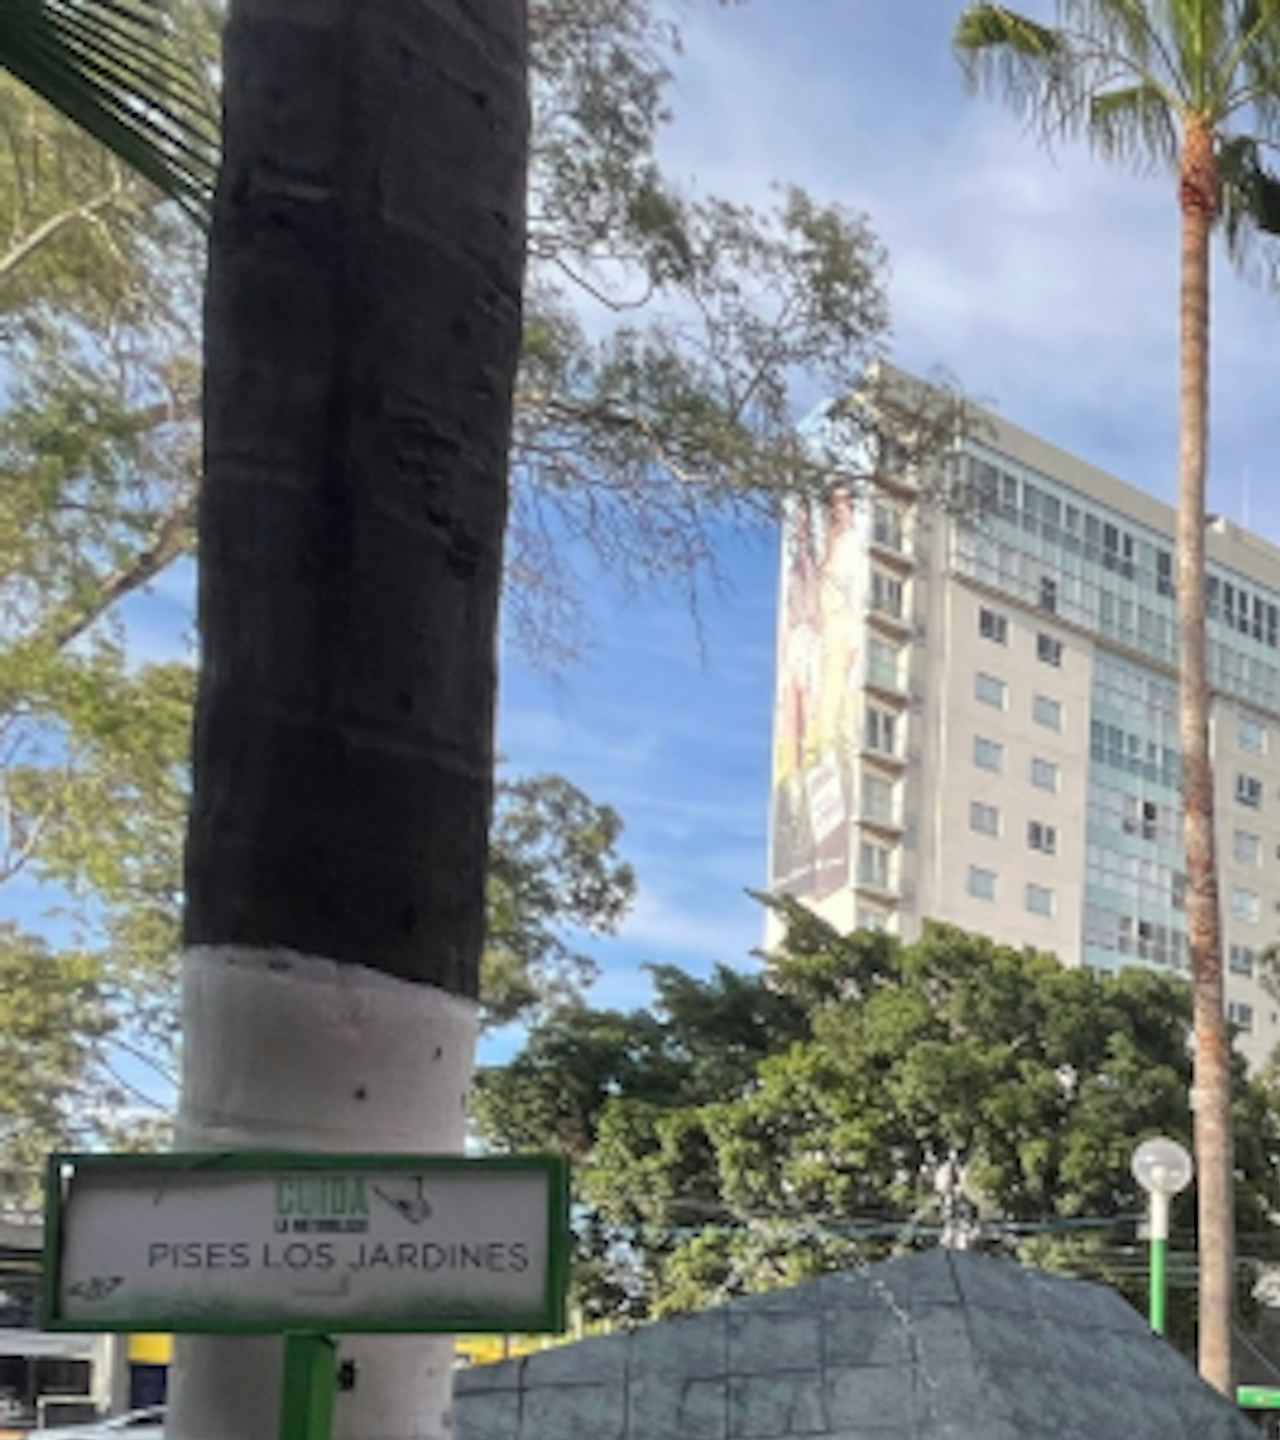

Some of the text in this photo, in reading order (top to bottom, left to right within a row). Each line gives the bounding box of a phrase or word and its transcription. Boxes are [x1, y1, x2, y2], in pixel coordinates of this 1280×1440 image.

[147, 1242, 530, 1273] PISES LOS JARDINES
